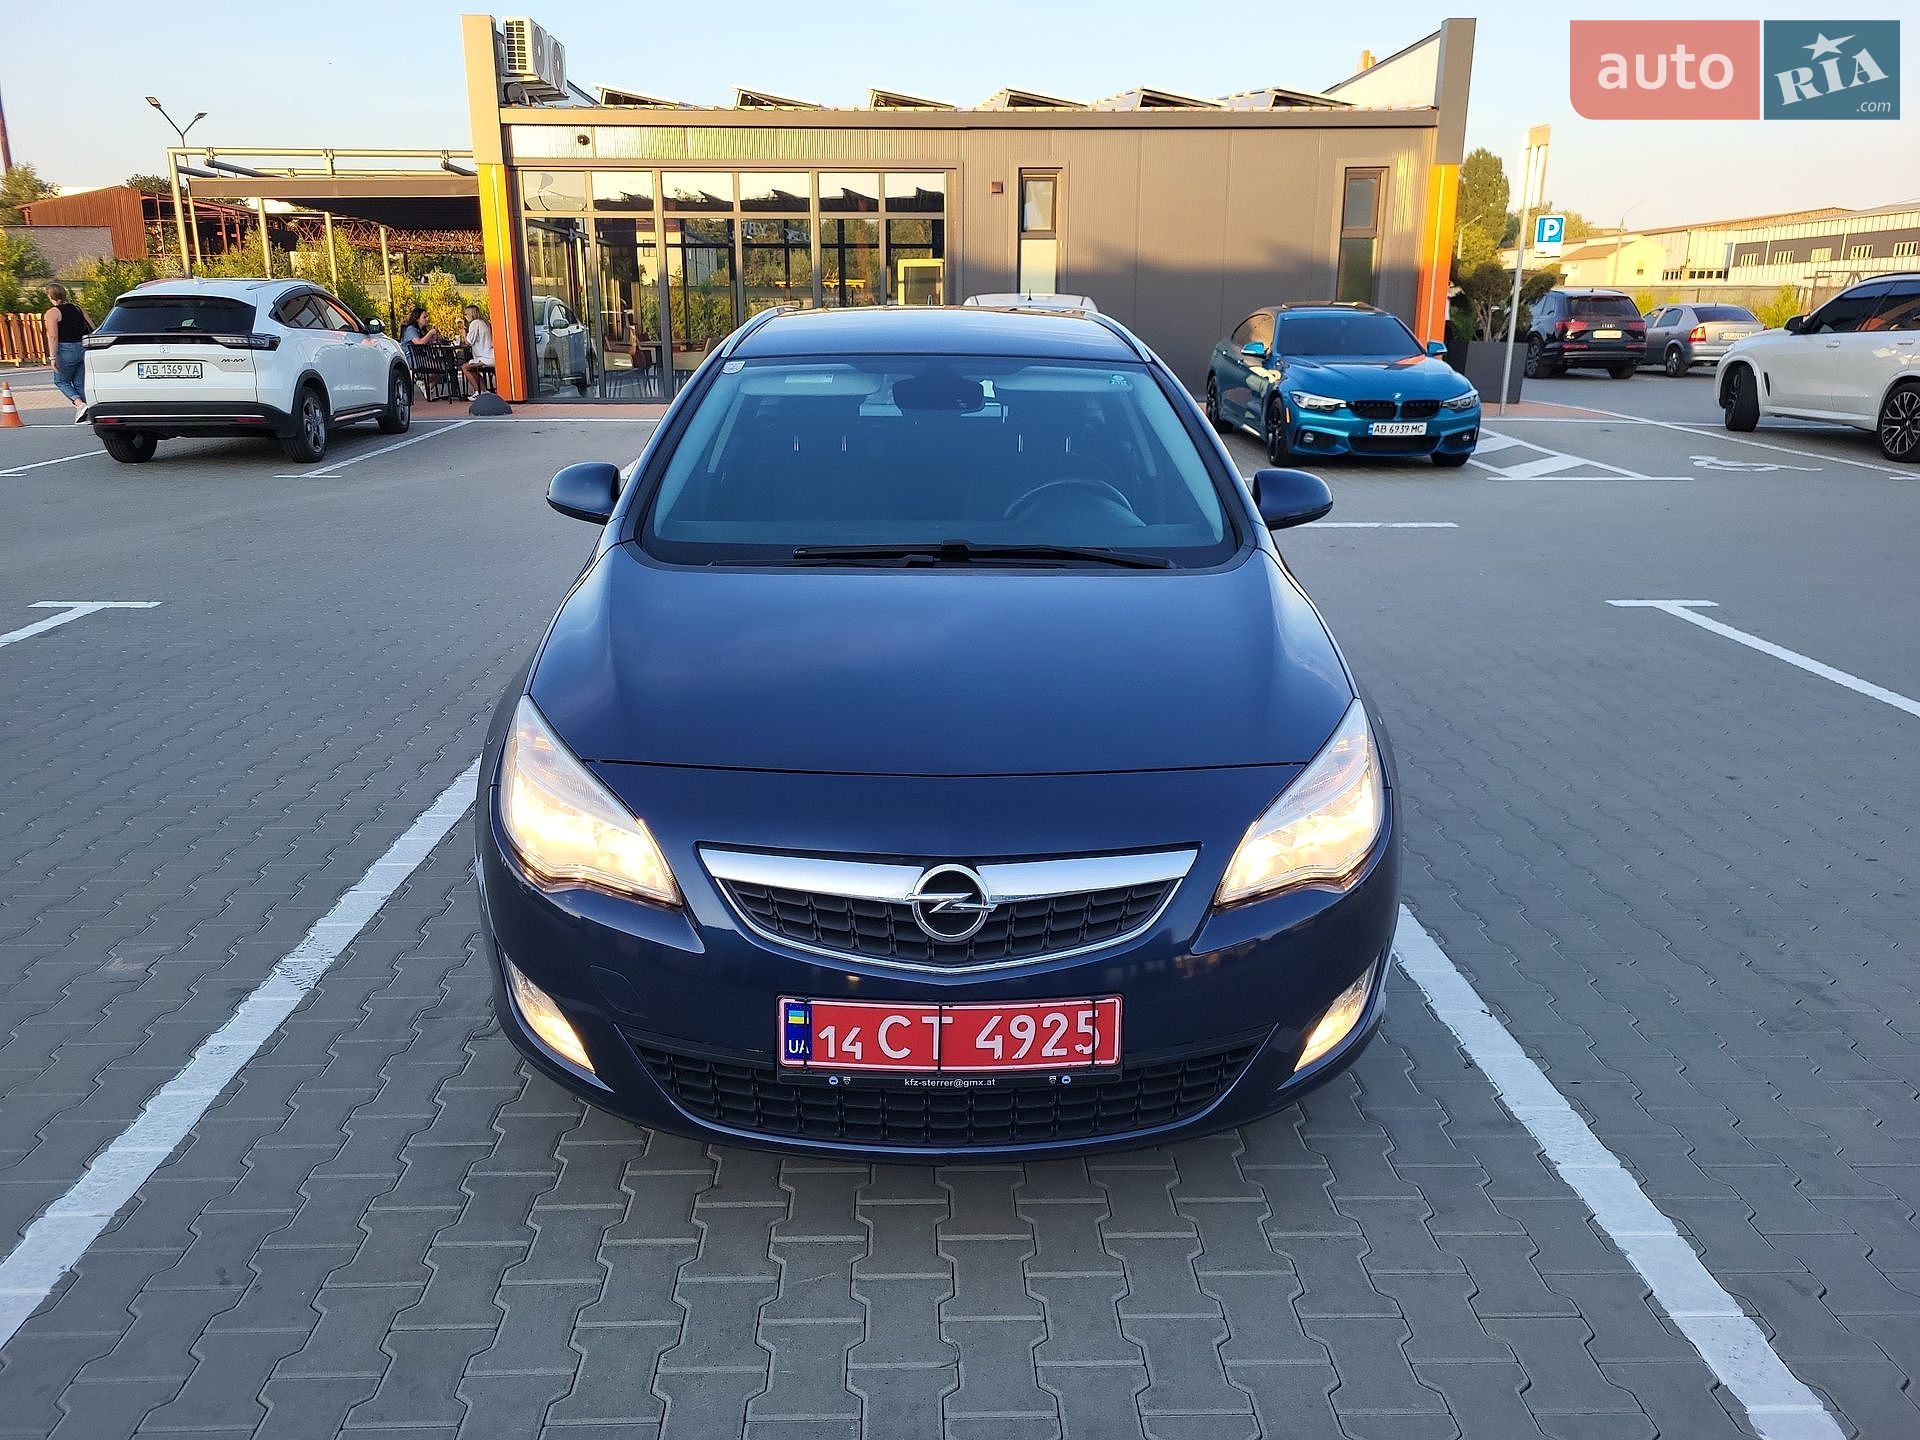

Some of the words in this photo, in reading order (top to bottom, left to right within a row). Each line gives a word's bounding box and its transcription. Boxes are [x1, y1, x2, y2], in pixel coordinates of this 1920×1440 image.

[1542, 218, 1561, 242] P
[145, 365, 159, 375] AB
[161, 365, 183, 375] 1369
[818, 1025, 863, 1060] 14
[877, 1014, 954, 1061] CT
[975, 1009, 1100, 1060] 4925
[788, 1039, 810, 1054] UA
[904, 1078, 996, 1088] kfz-sterrer@gmx.at
